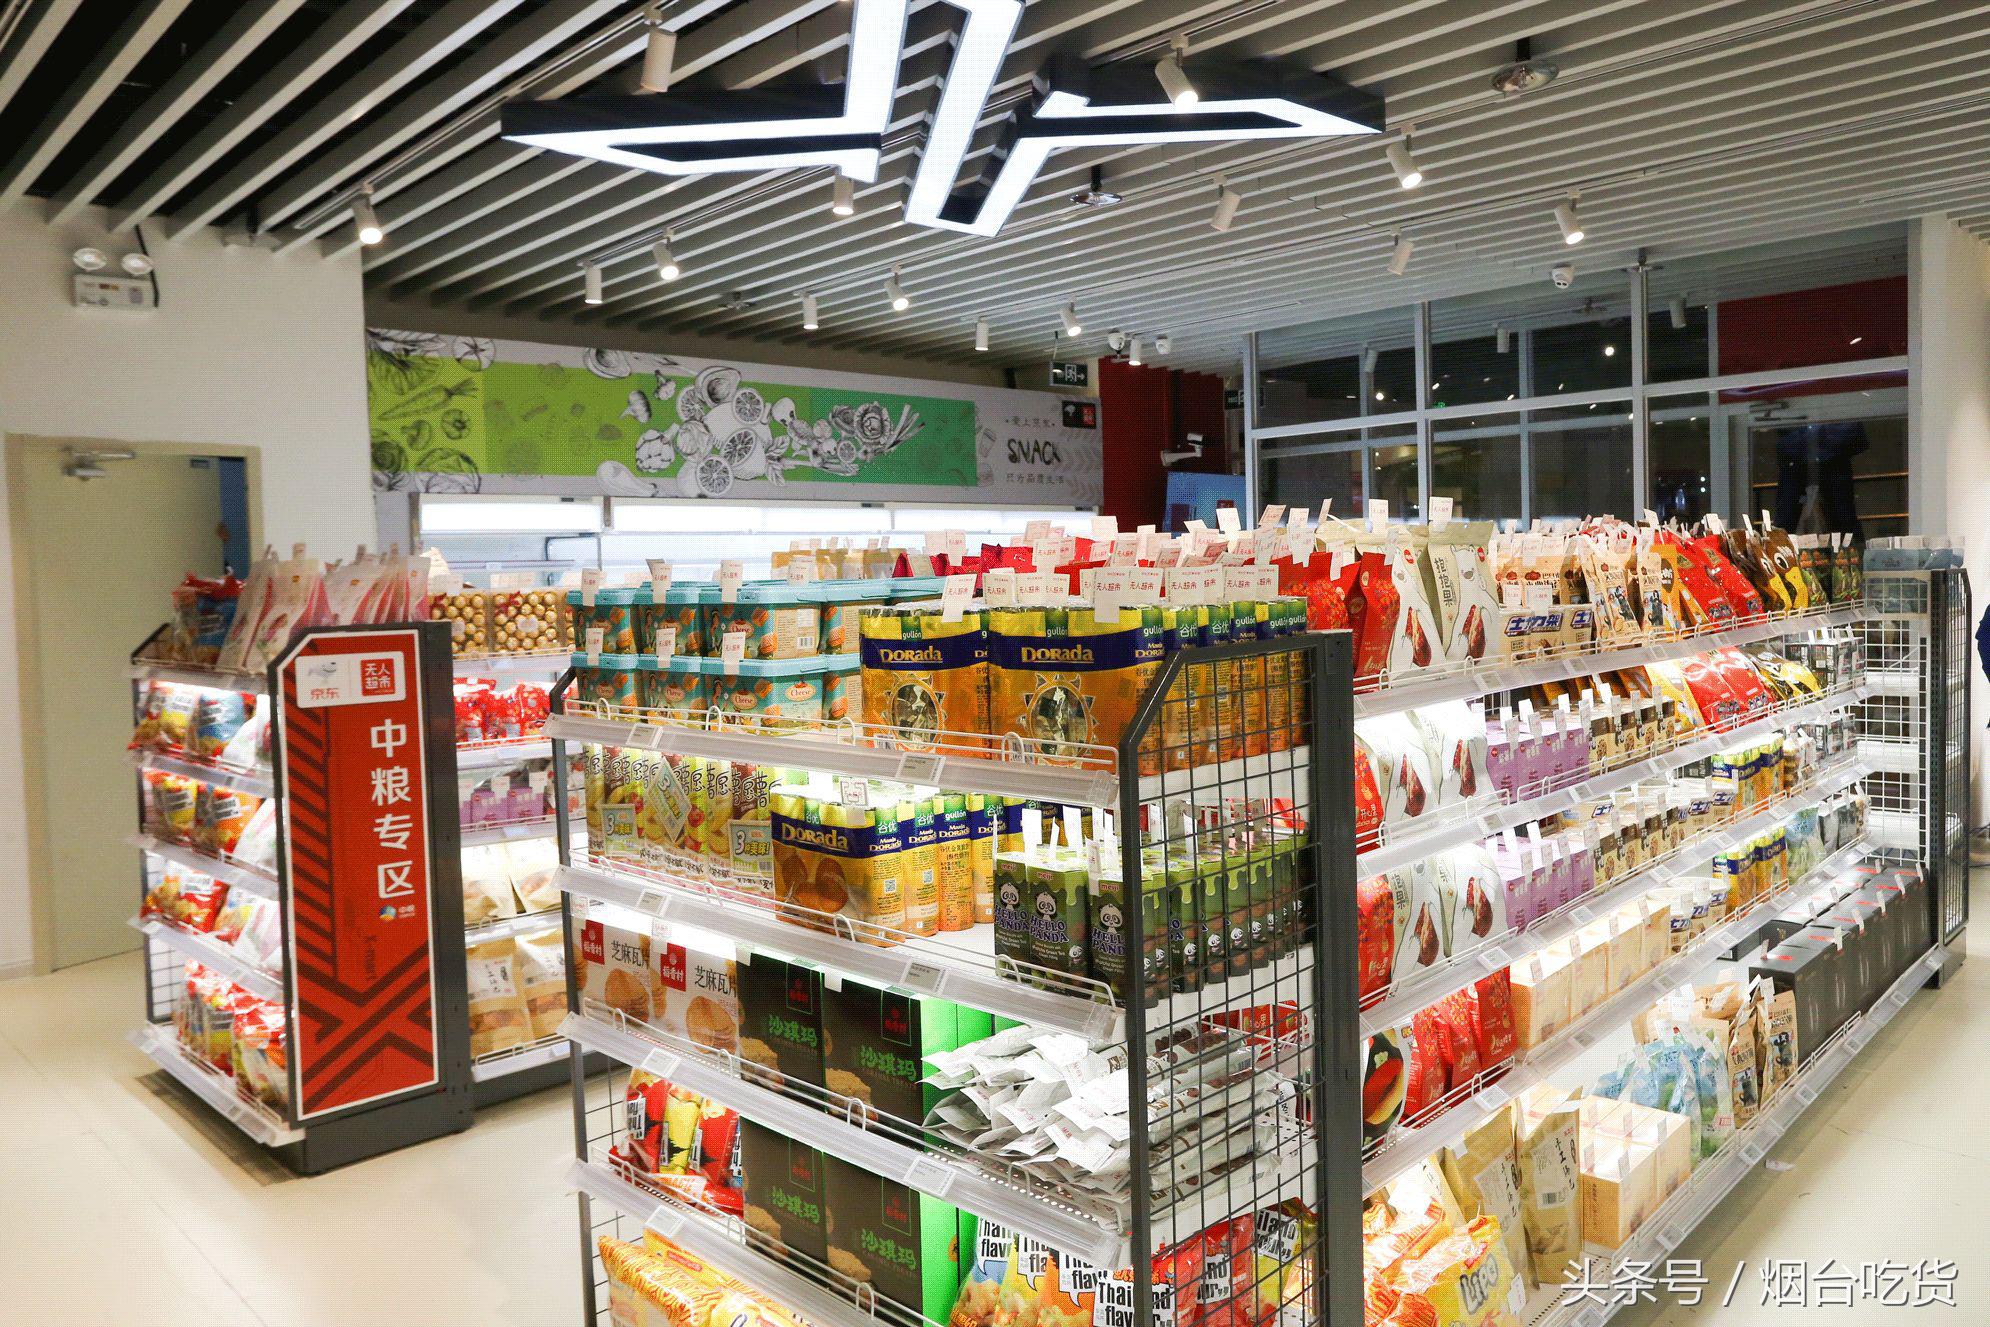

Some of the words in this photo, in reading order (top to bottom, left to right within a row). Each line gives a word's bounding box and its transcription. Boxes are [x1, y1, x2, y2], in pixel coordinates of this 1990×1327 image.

[1096, 582, 1121, 592] 无人超市
[1129, 581, 1154, 591] 无人超市
[1171, 582, 1197, 590] 无人超市
[1226, 580, 1250, 588] 无人超市
[364, 663, 391, 676] 无人
[365, 676, 392, 690] 超市
[311, 687, 340, 700] 京东
[370, 718, 416, 899] 中粮专区
[944, 809, 967, 821] gullón
[878, 820, 898, 834] 谷优
[1101, 884, 1120, 892] meiji
[1031, 914, 1066, 931] HELLO
[1030, 926, 1069, 943] PANDA
[1092, 928, 1125, 945] HELL
[583, 941, 603, 957] 稻香村
[611, 940, 651, 970] 芝麻瓦片
[662, 966, 684, 983] 稻香村
[694, 965, 738, 998] 芝麻瓦片
[1459, 1253, 1499, 1315] Lipo
